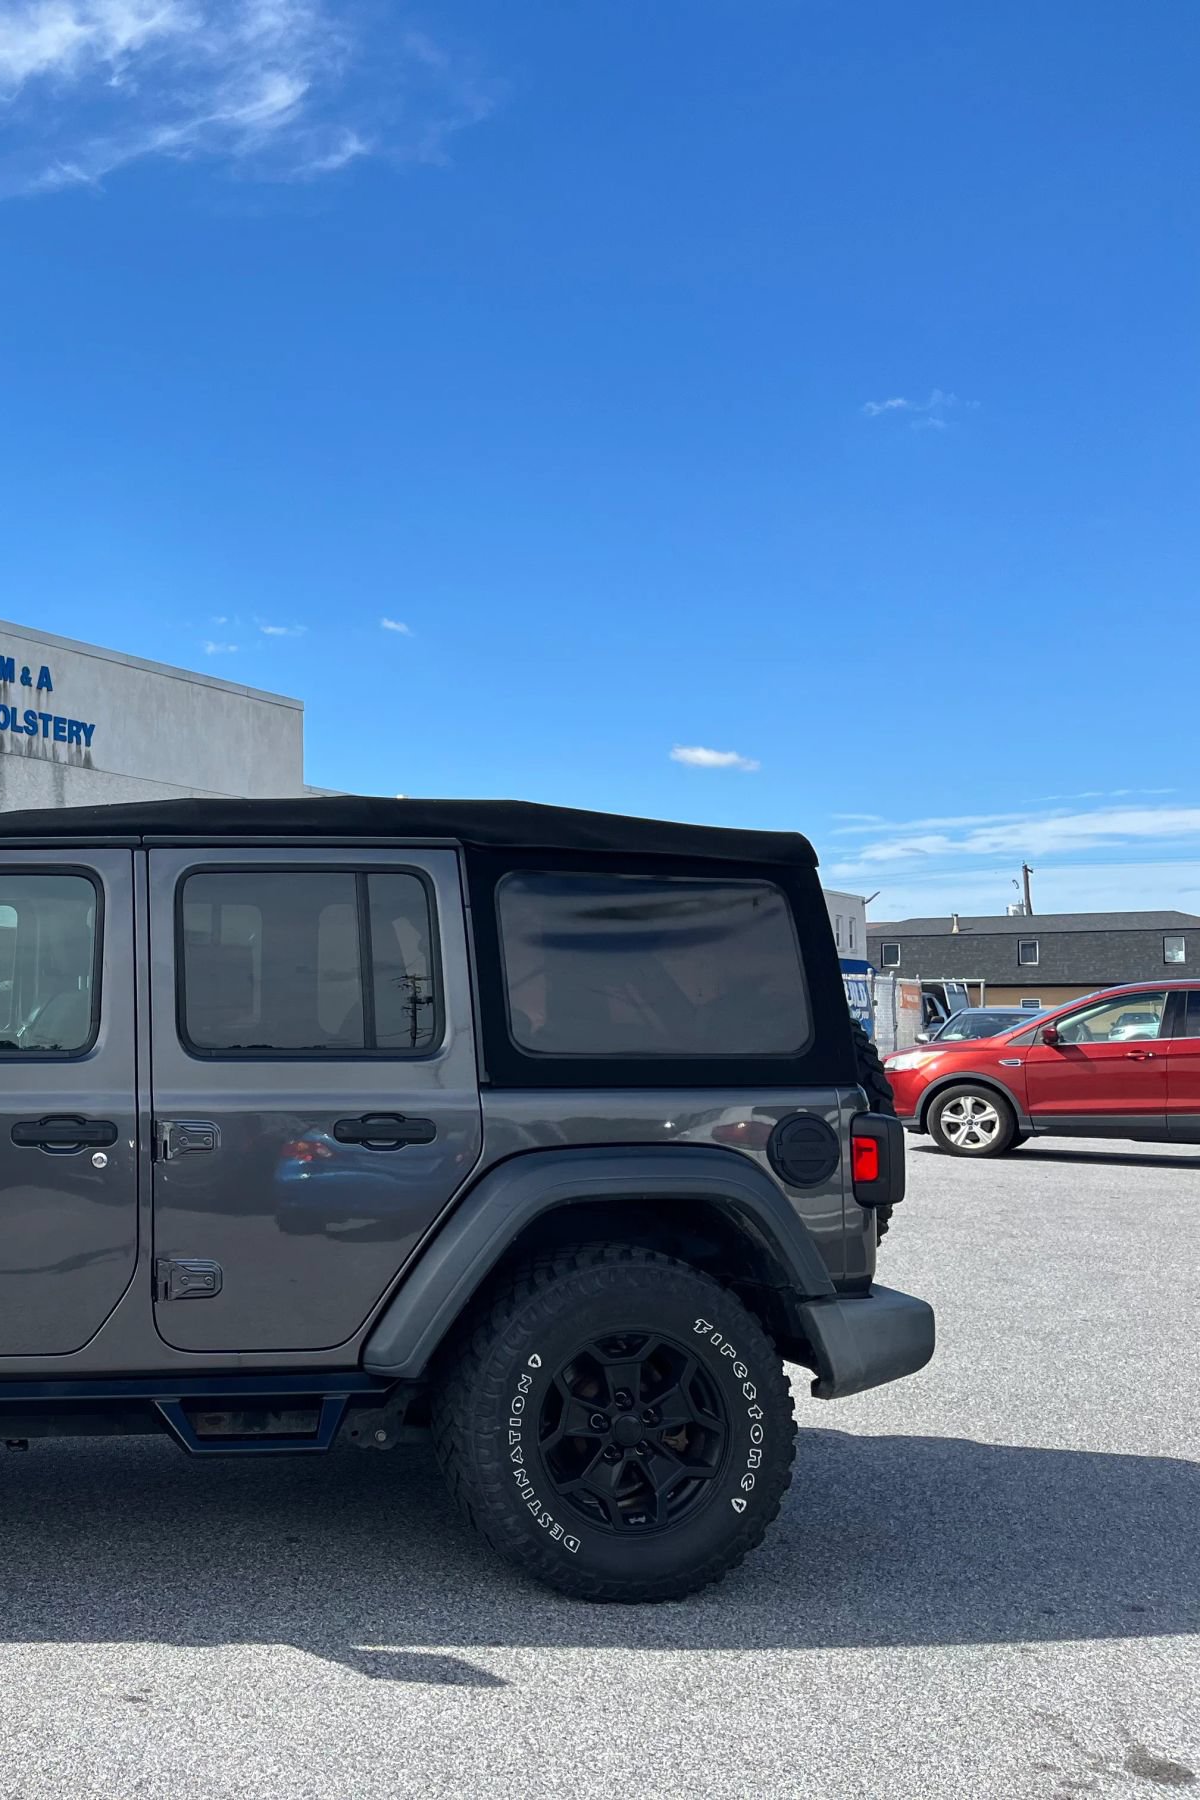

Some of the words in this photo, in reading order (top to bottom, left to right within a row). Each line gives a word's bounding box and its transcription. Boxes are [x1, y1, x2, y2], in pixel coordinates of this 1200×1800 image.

[20, 666, 32, 687] &
[36, 665, 53, 692] A
[508, 1374, 581, 1553] DESTINATION
